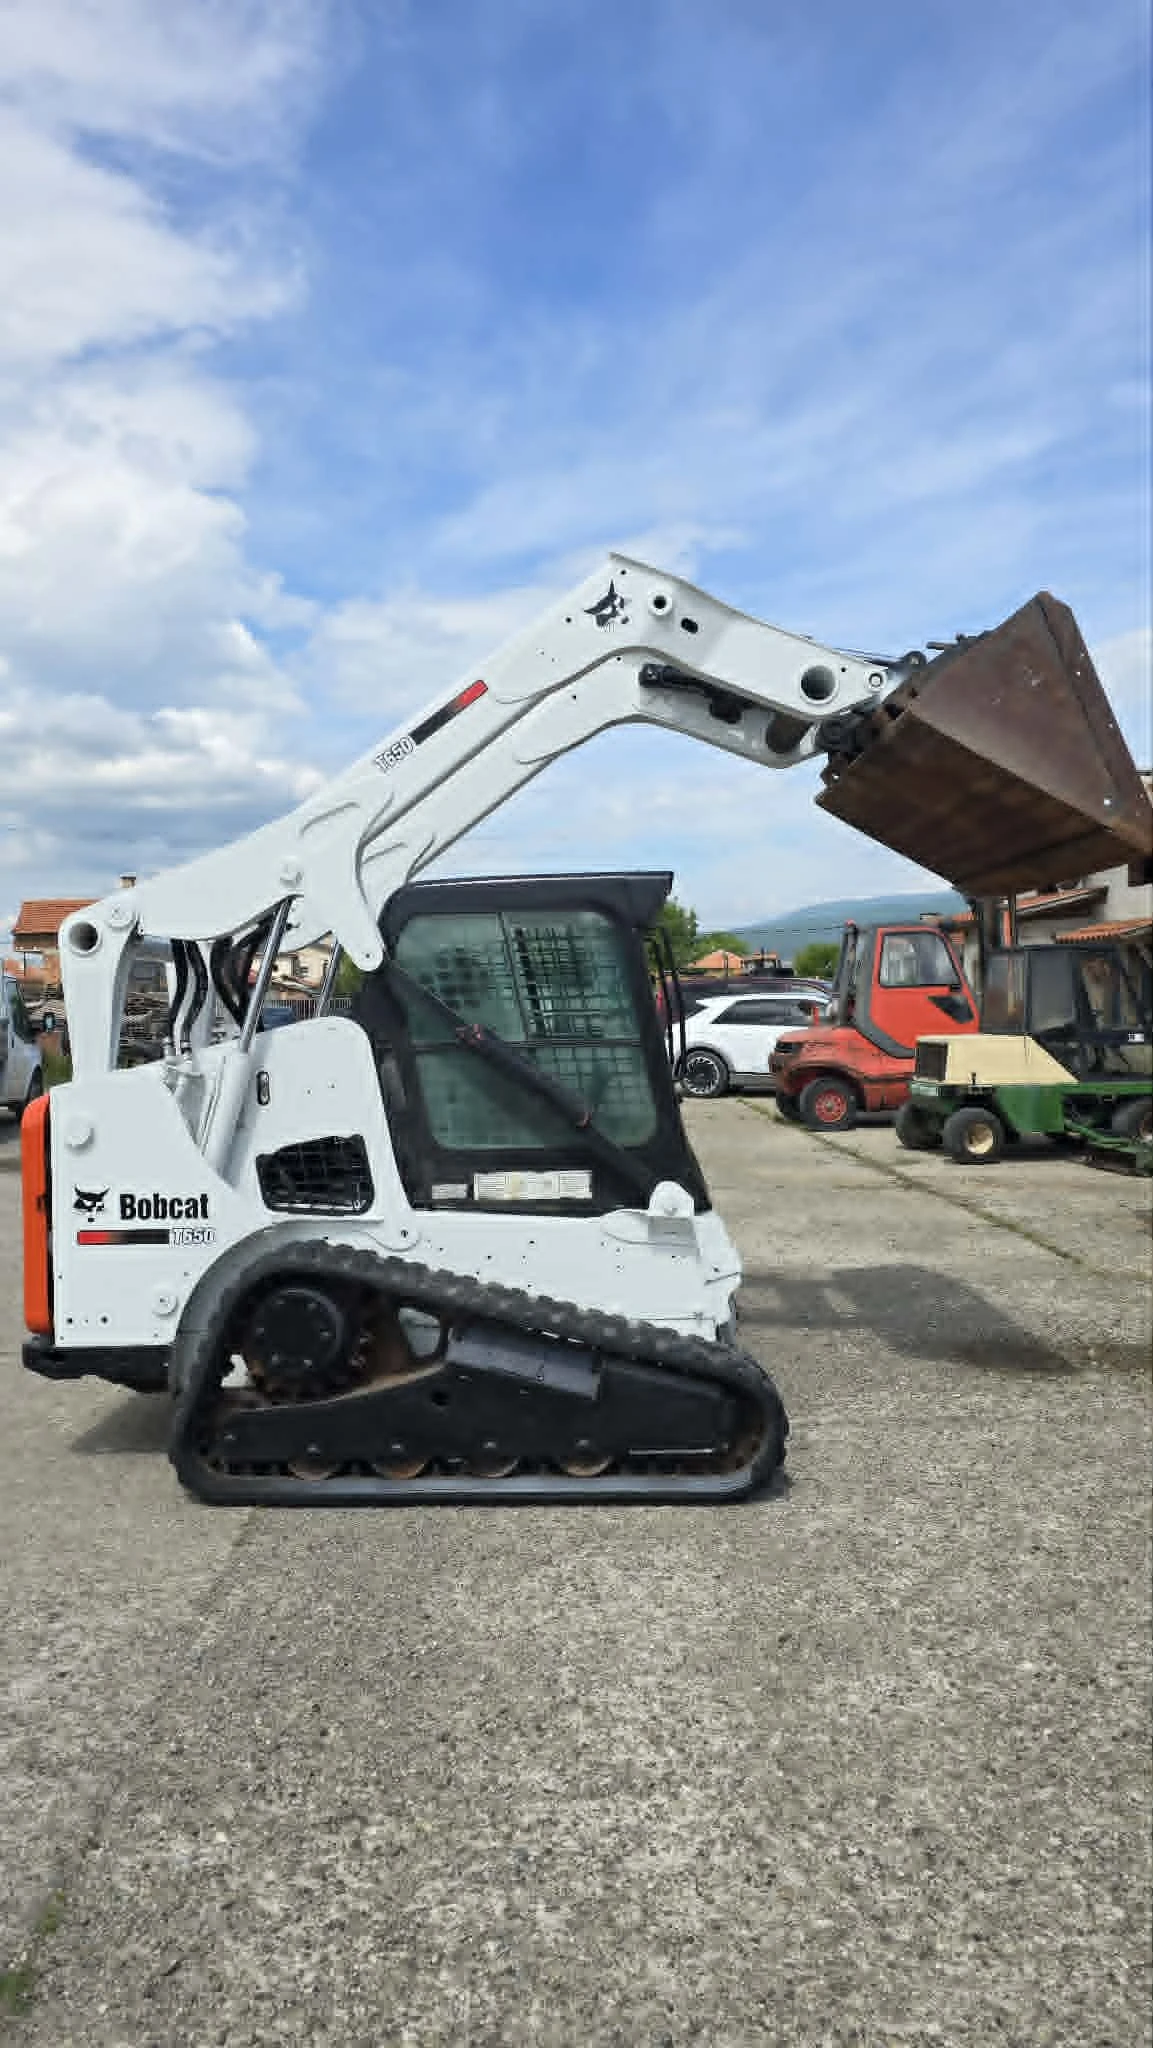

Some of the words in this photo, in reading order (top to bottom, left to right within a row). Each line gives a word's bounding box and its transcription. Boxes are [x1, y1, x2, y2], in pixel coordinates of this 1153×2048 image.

[375, 736, 415, 773] T650
[119, 1193, 209, 1220] Bobcat
[171, 1227, 214, 1246] T650
